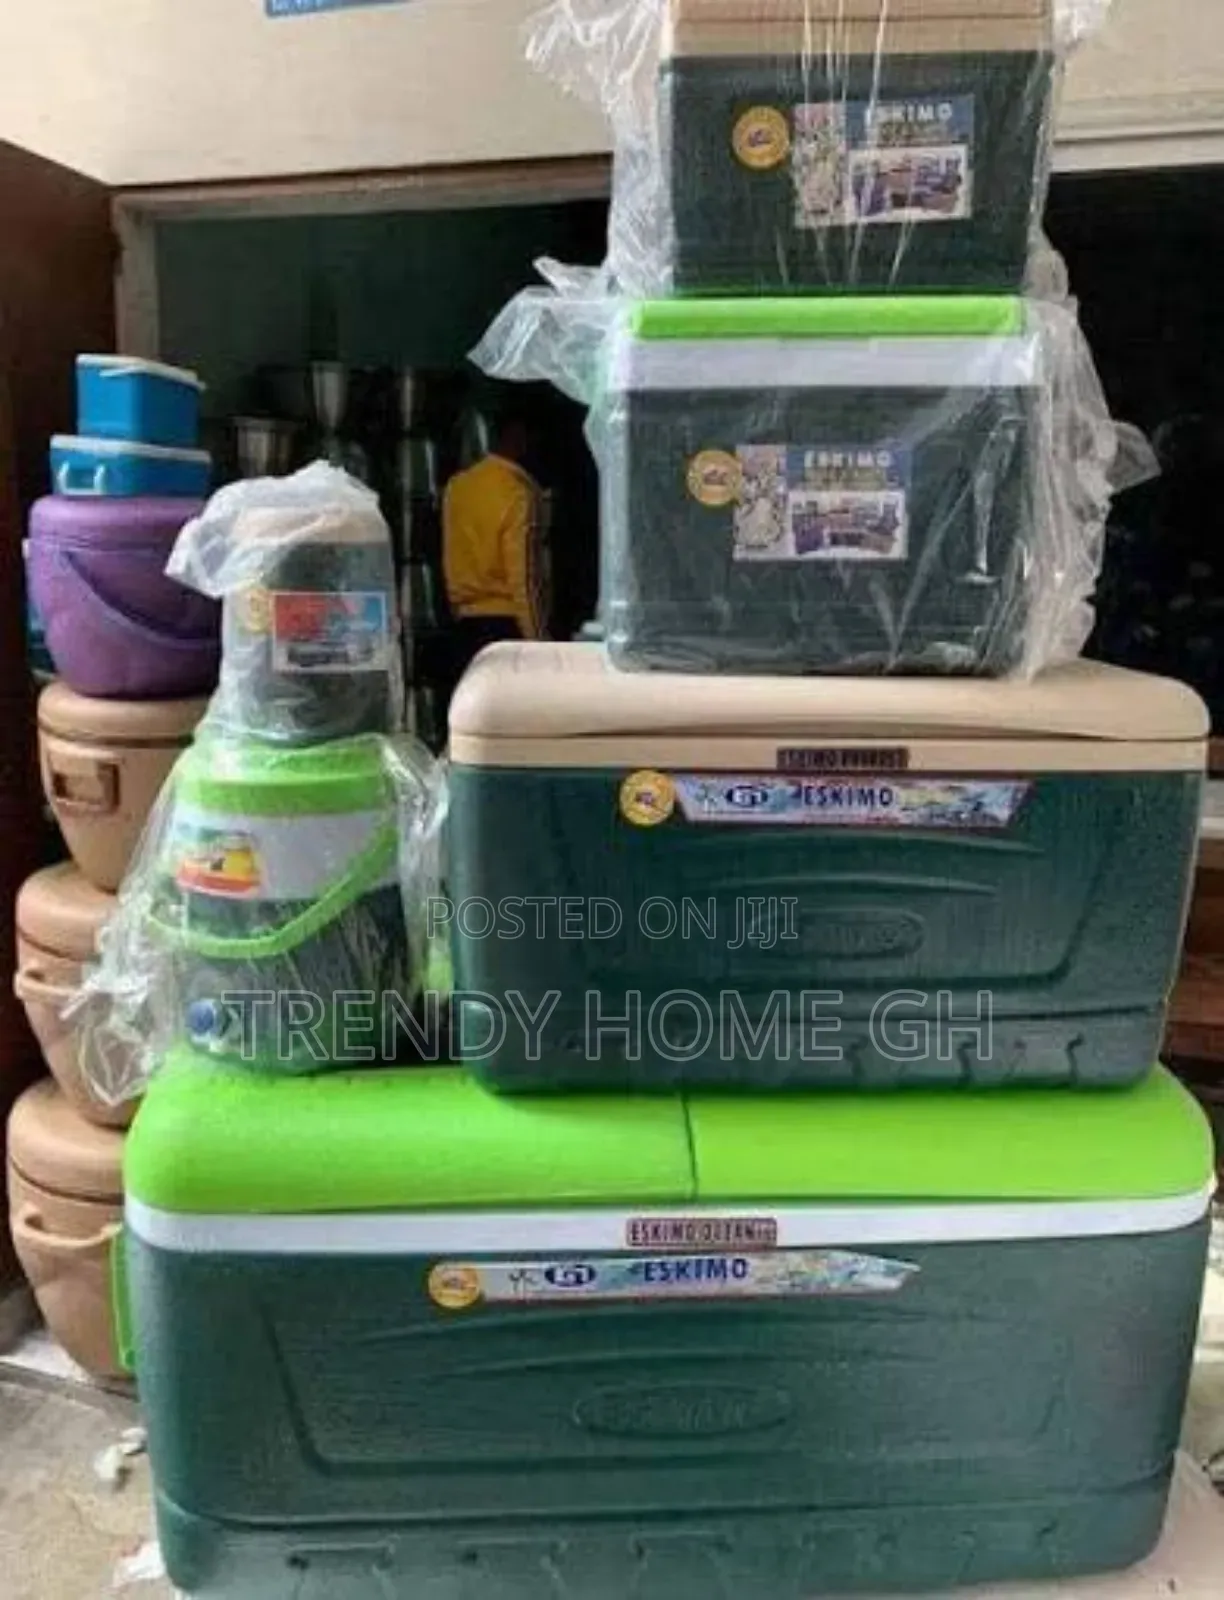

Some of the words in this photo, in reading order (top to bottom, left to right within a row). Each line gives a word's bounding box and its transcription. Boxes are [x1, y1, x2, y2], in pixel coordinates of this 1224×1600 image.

[803, 785, 894, 807] ESKIMO
[630, 1222, 696, 1243] ESKIMO
[643, 1257, 749, 1282] ESKIMO
